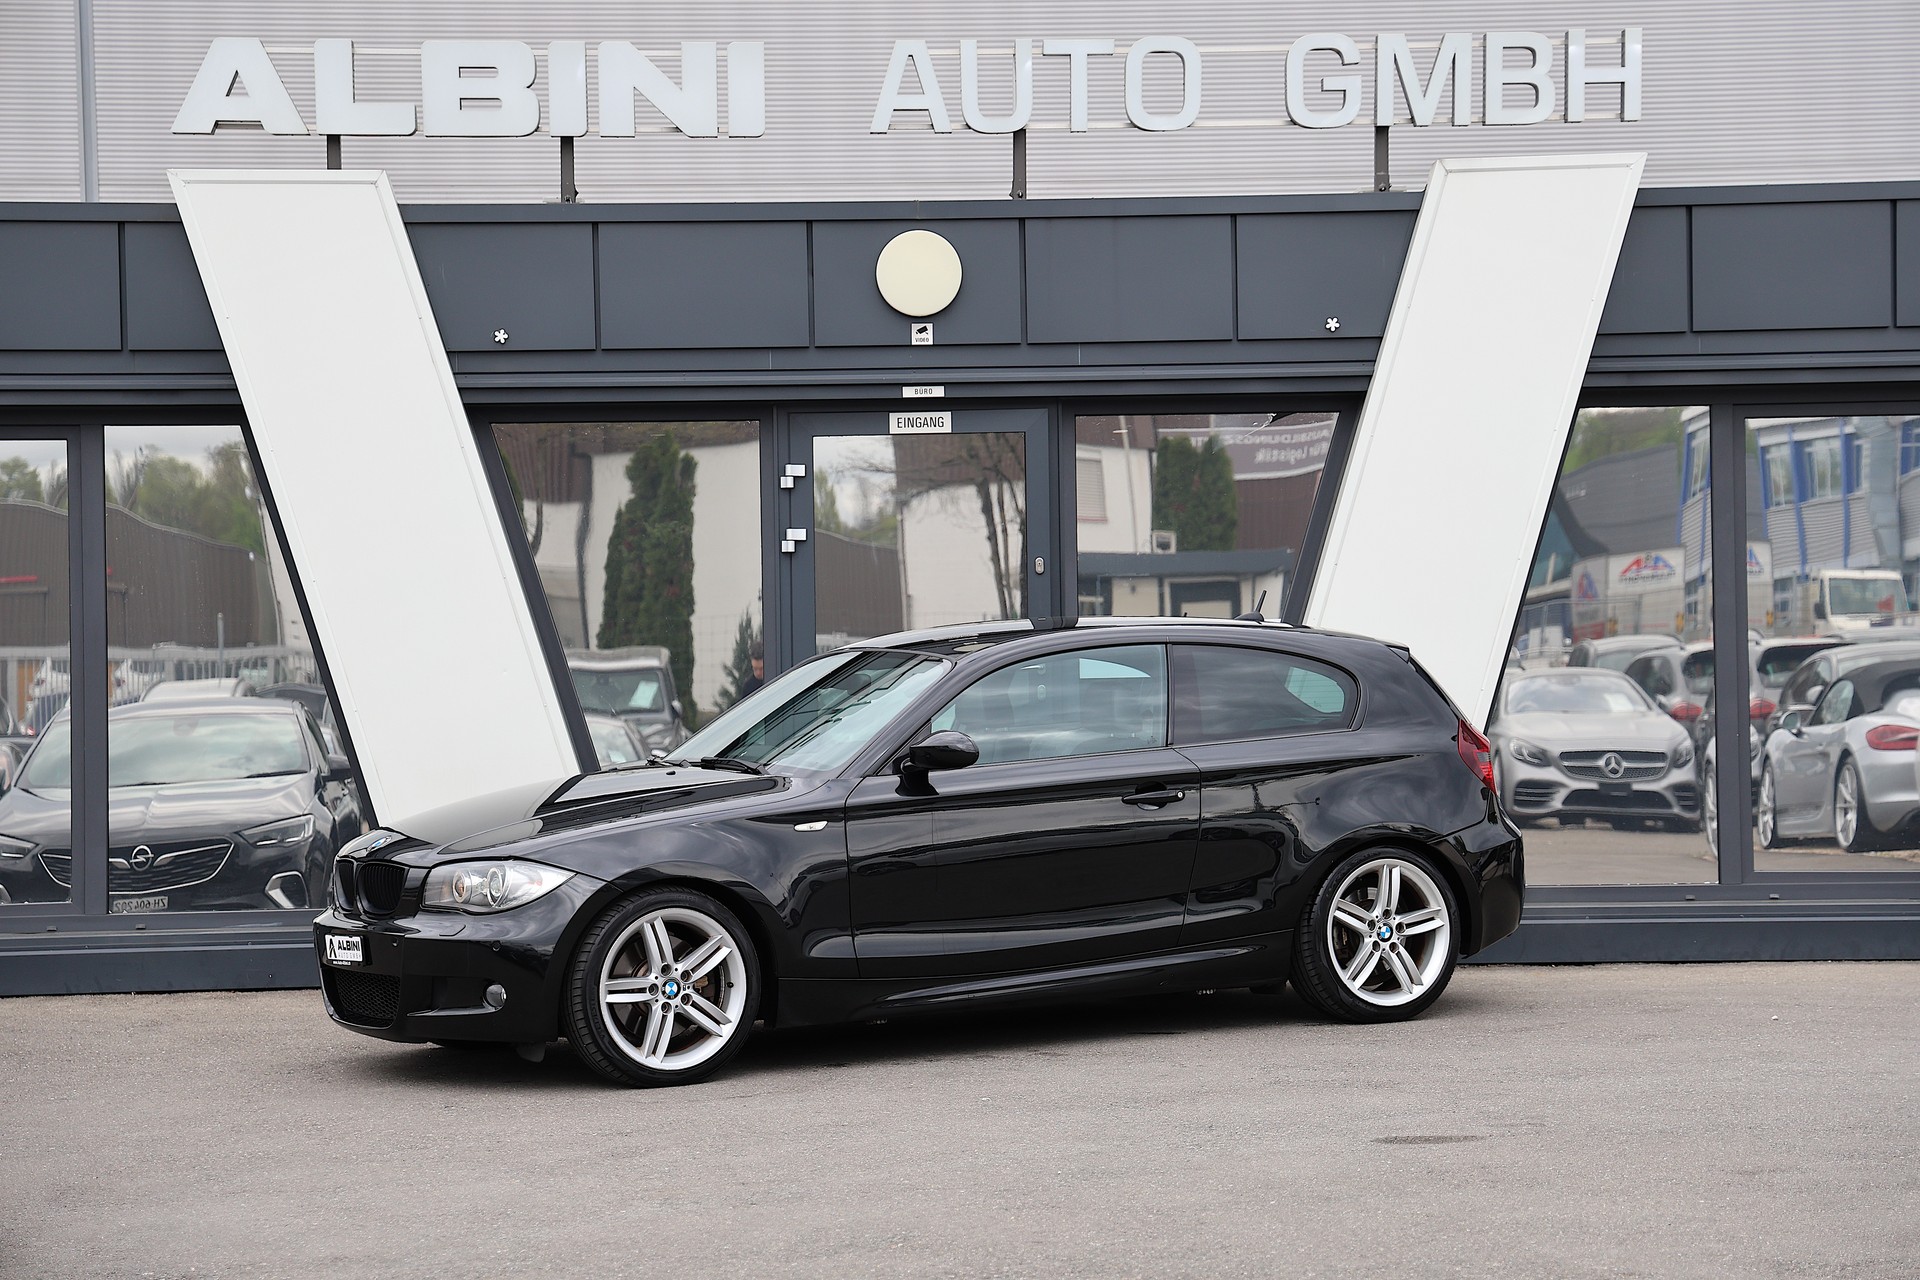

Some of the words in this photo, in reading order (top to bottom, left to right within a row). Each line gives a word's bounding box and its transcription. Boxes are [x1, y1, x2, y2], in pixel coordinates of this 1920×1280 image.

[171, 37, 766, 138] ALBINI
[869, 36, 1202, 135] AUTO
[1284, 28, 1643, 129] GMBH
[897, 417, 944, 428] EINGANG
[338, 940, 360, 951] ALBINI
